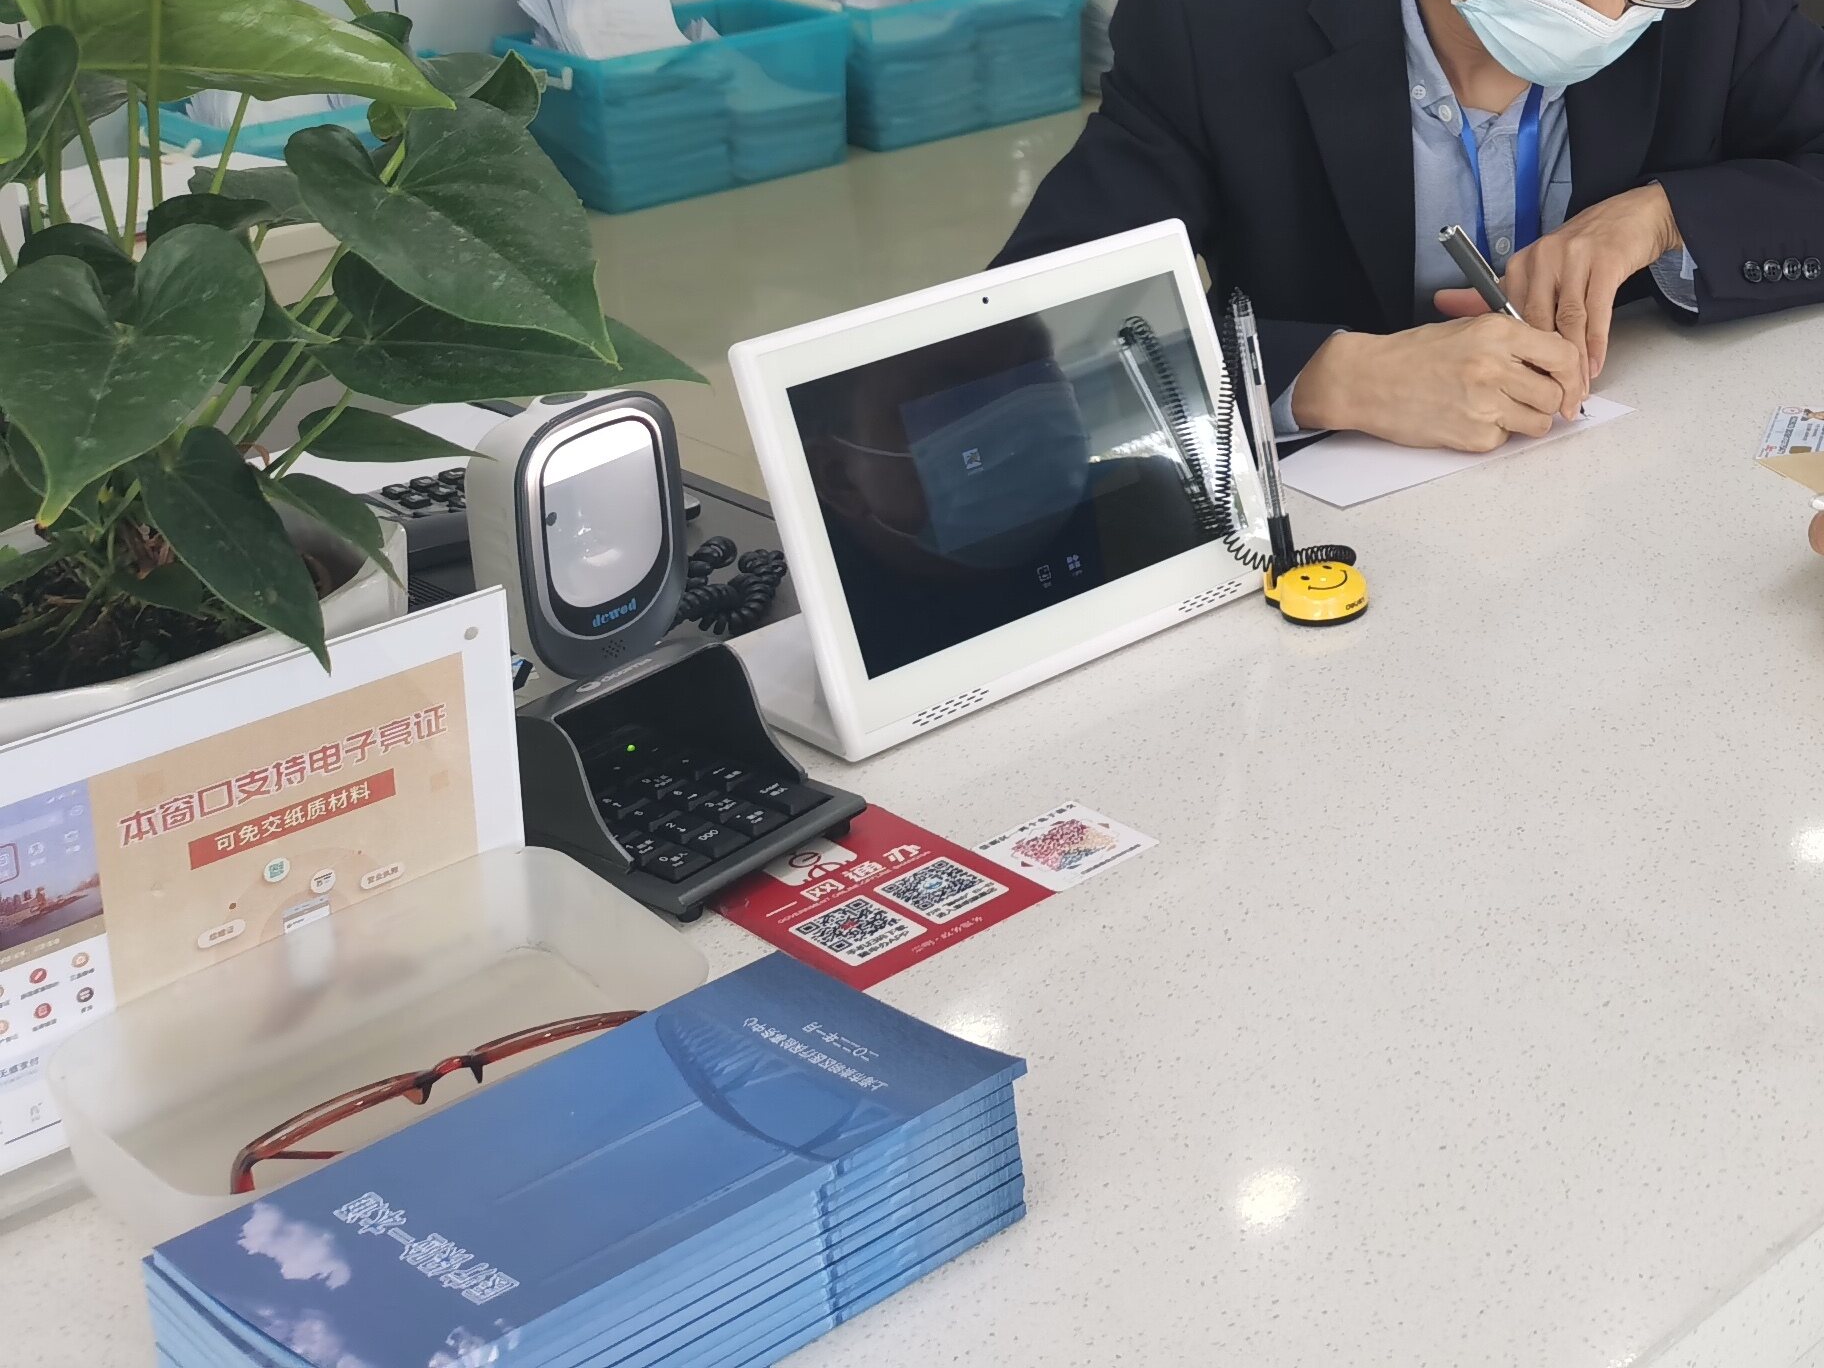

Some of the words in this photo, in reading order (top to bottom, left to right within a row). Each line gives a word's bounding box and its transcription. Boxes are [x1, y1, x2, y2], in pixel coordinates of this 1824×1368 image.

[118, 702, 449, 848] 本窗口支持电子亮证
[215, 783, 373, 853] 可免交纸质材料
[765, 843, 922, 918] 一网通办
[332, 1191, 520, 1306] 医疗保险一本通
